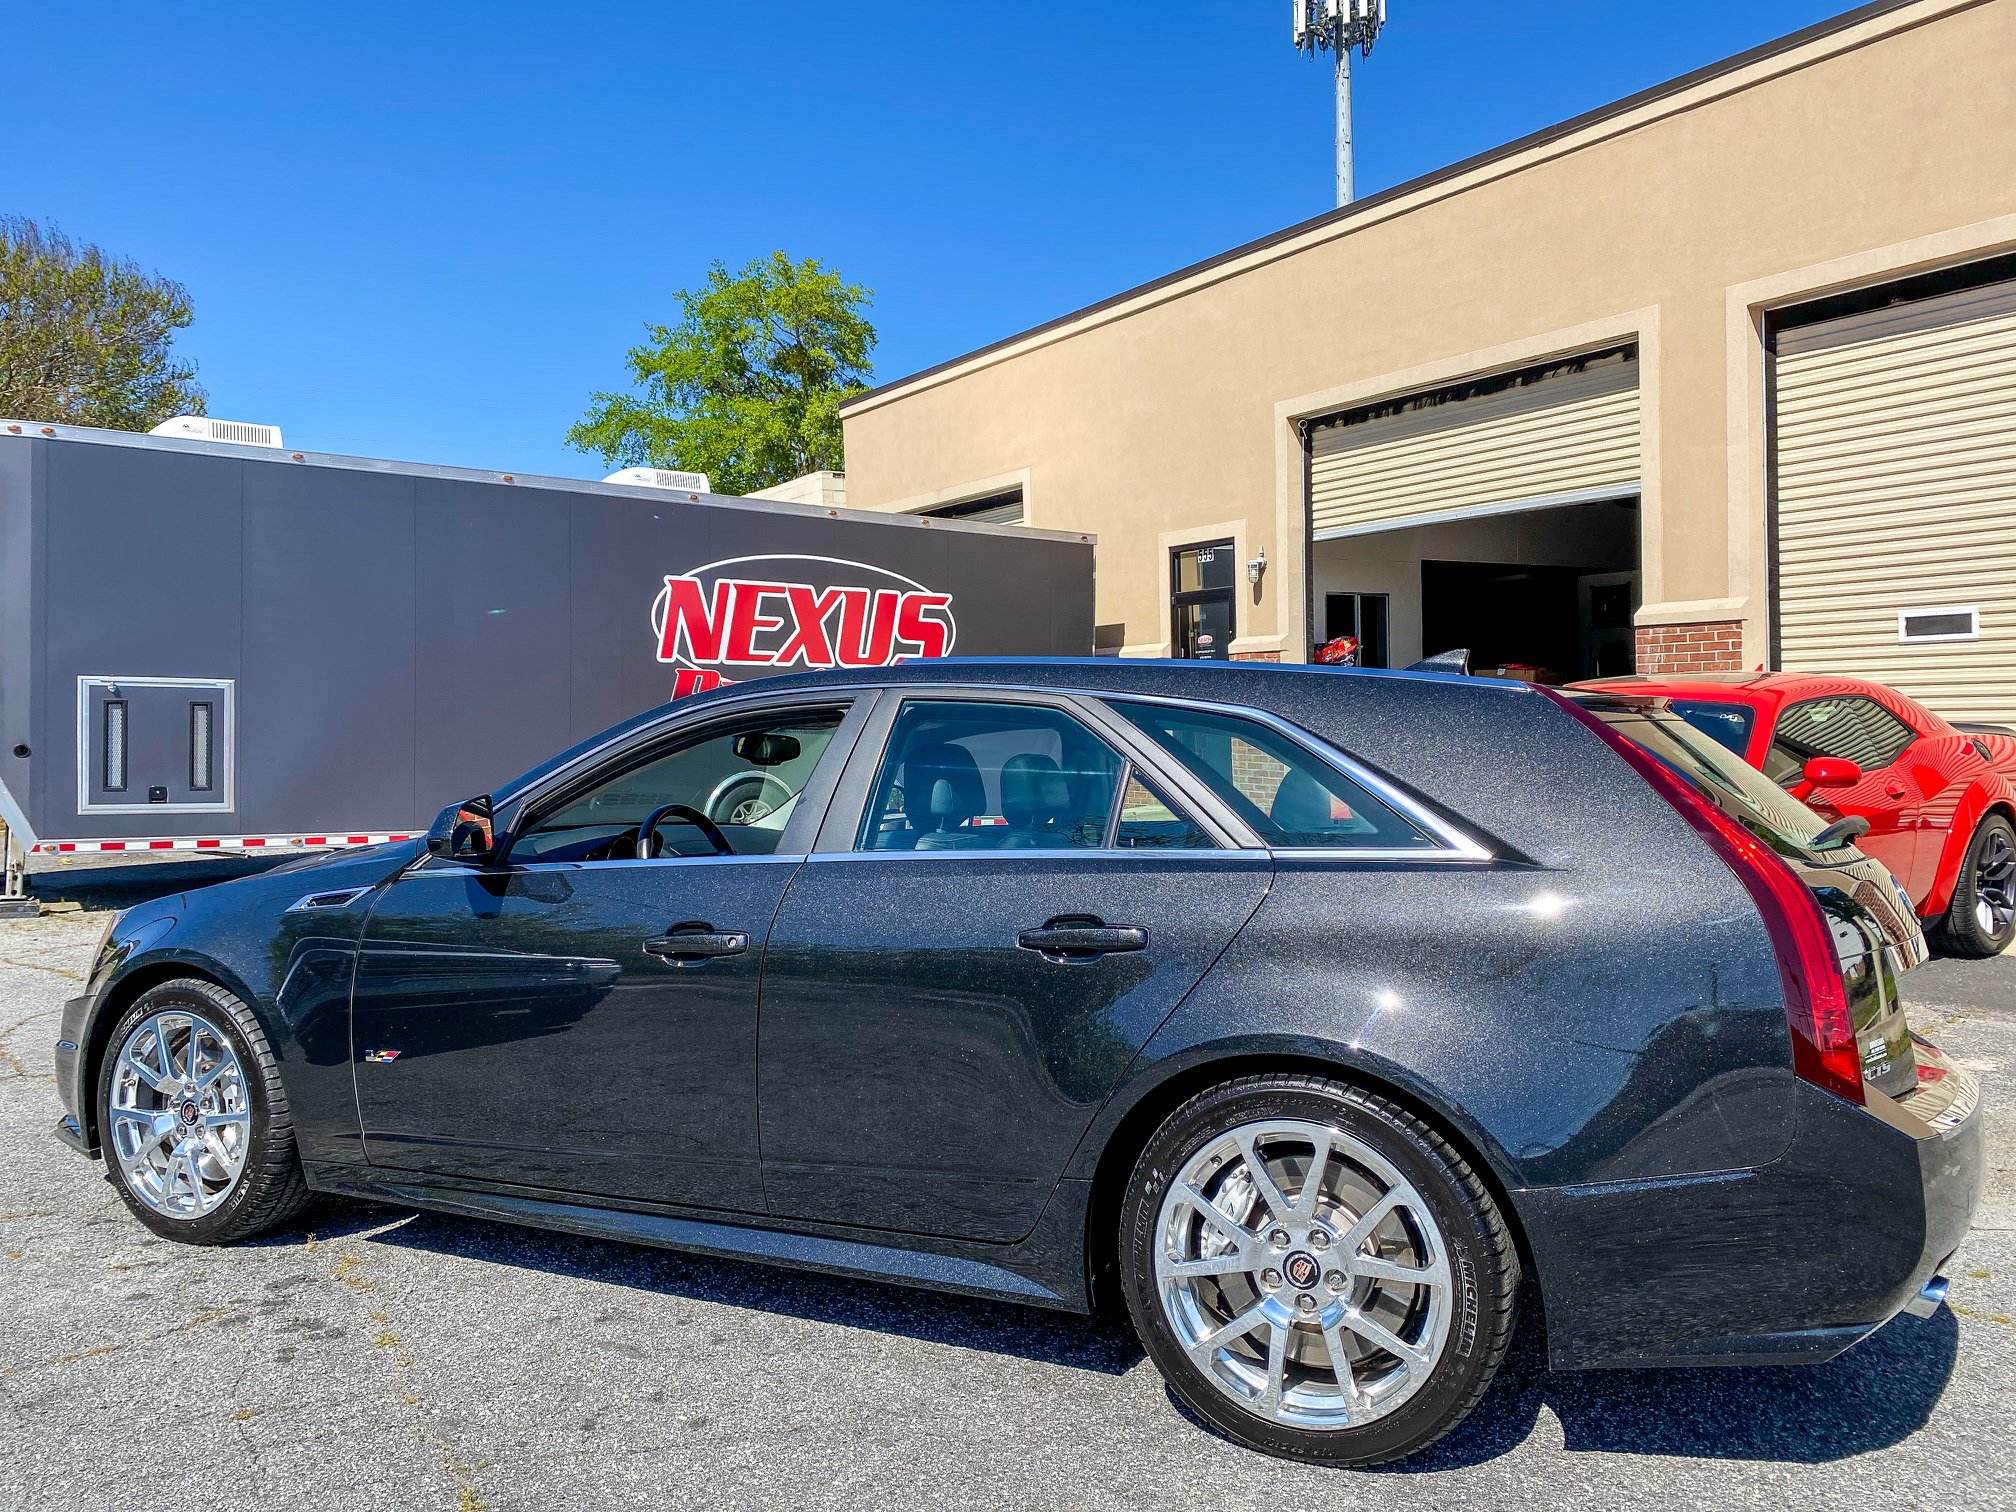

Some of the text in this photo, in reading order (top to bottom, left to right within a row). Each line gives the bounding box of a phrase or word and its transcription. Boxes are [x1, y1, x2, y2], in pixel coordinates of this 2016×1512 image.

[1198, 549, 1213, 561] 555
[656, 575, 953, 667] NEXUS
[1458, 1259, 1478, 1357] MICHELIN
